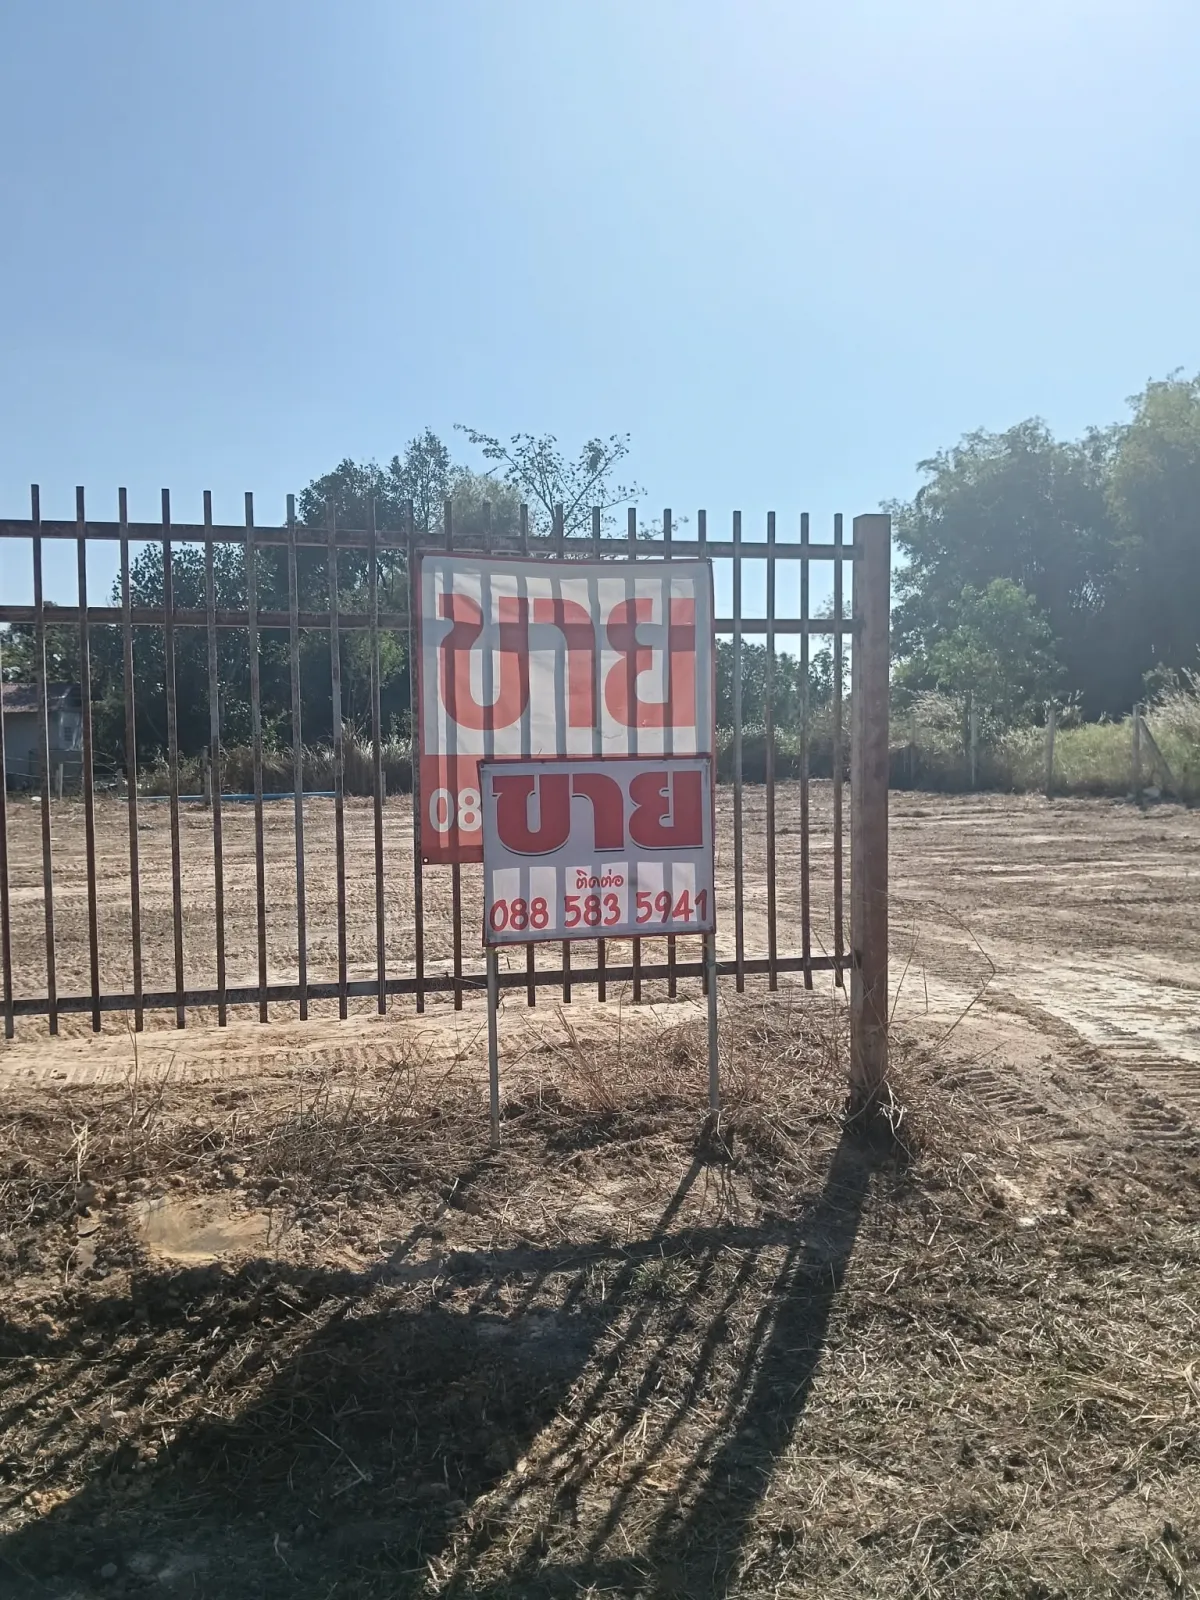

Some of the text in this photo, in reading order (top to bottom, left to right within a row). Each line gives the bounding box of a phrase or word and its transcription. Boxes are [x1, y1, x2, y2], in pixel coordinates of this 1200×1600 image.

[438, 593, 696, 730] ขาย
[492, 770, 704, 856] ขาย
[489, 889, 708, 932] 088 583 5941
[576, 869, 625, 889] ติดต่อ
